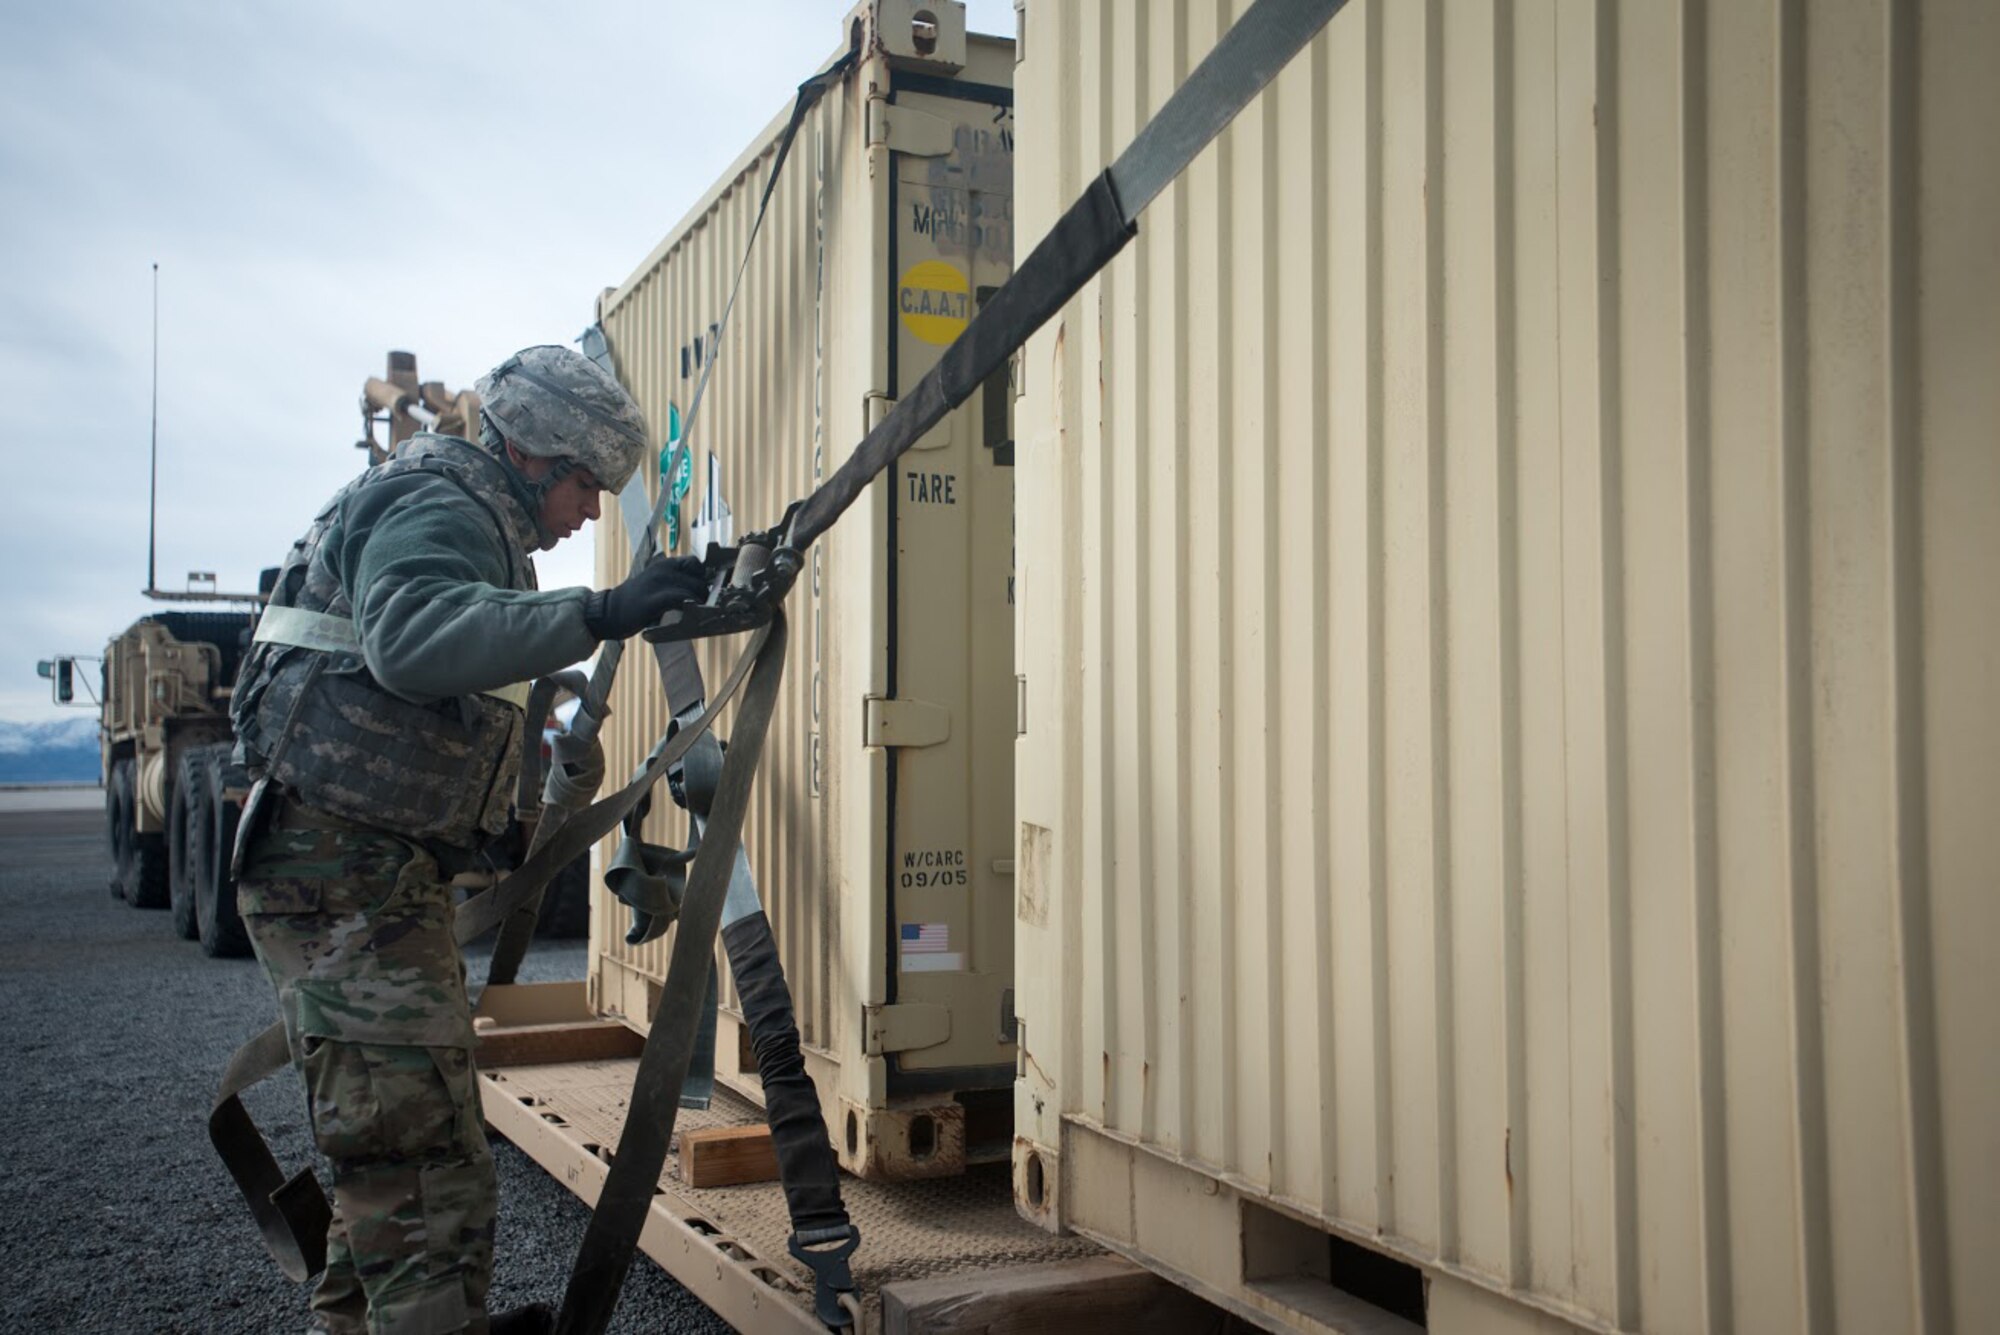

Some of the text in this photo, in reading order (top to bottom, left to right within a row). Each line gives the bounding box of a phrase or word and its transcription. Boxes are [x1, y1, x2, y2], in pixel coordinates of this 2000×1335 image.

[907, 472, 956, 504] TARE
[904, 850, 964, 868] W/CARC
[901, 870, 967, 888] 09/05
